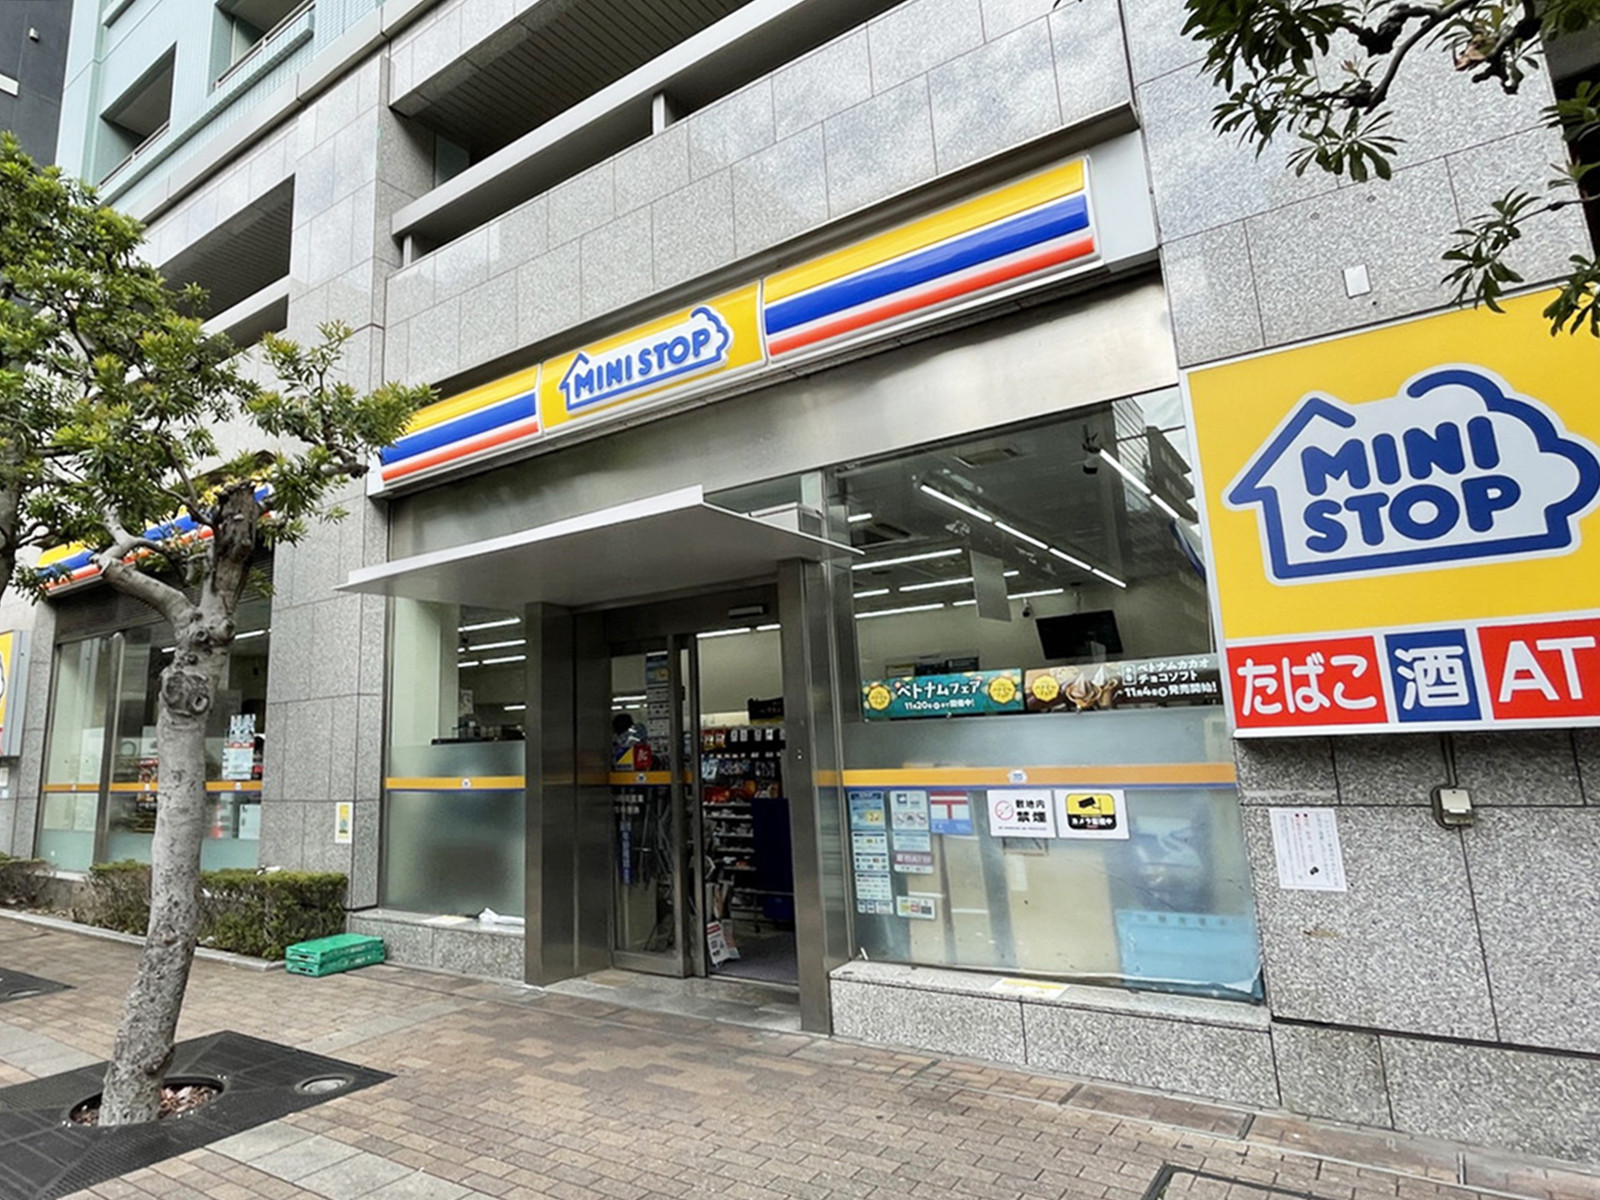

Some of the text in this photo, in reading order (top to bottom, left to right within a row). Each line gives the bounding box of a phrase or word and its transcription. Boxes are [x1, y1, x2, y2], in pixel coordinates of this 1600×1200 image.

[574, 328, 711, 399] MINI STOP
[1300, 415, 1500, 496] MINI
[1303, 475, 1521, 553] STOP
[897, 680, 981, 699] ベトナムフェア
[1138, 669, 1198, 685] チョコソフト
[1237, 652, 1377, 716] たばこ
[1394, 645, 1469, 710] 酒
[1016, 811, 1047, 823] 禁煙
